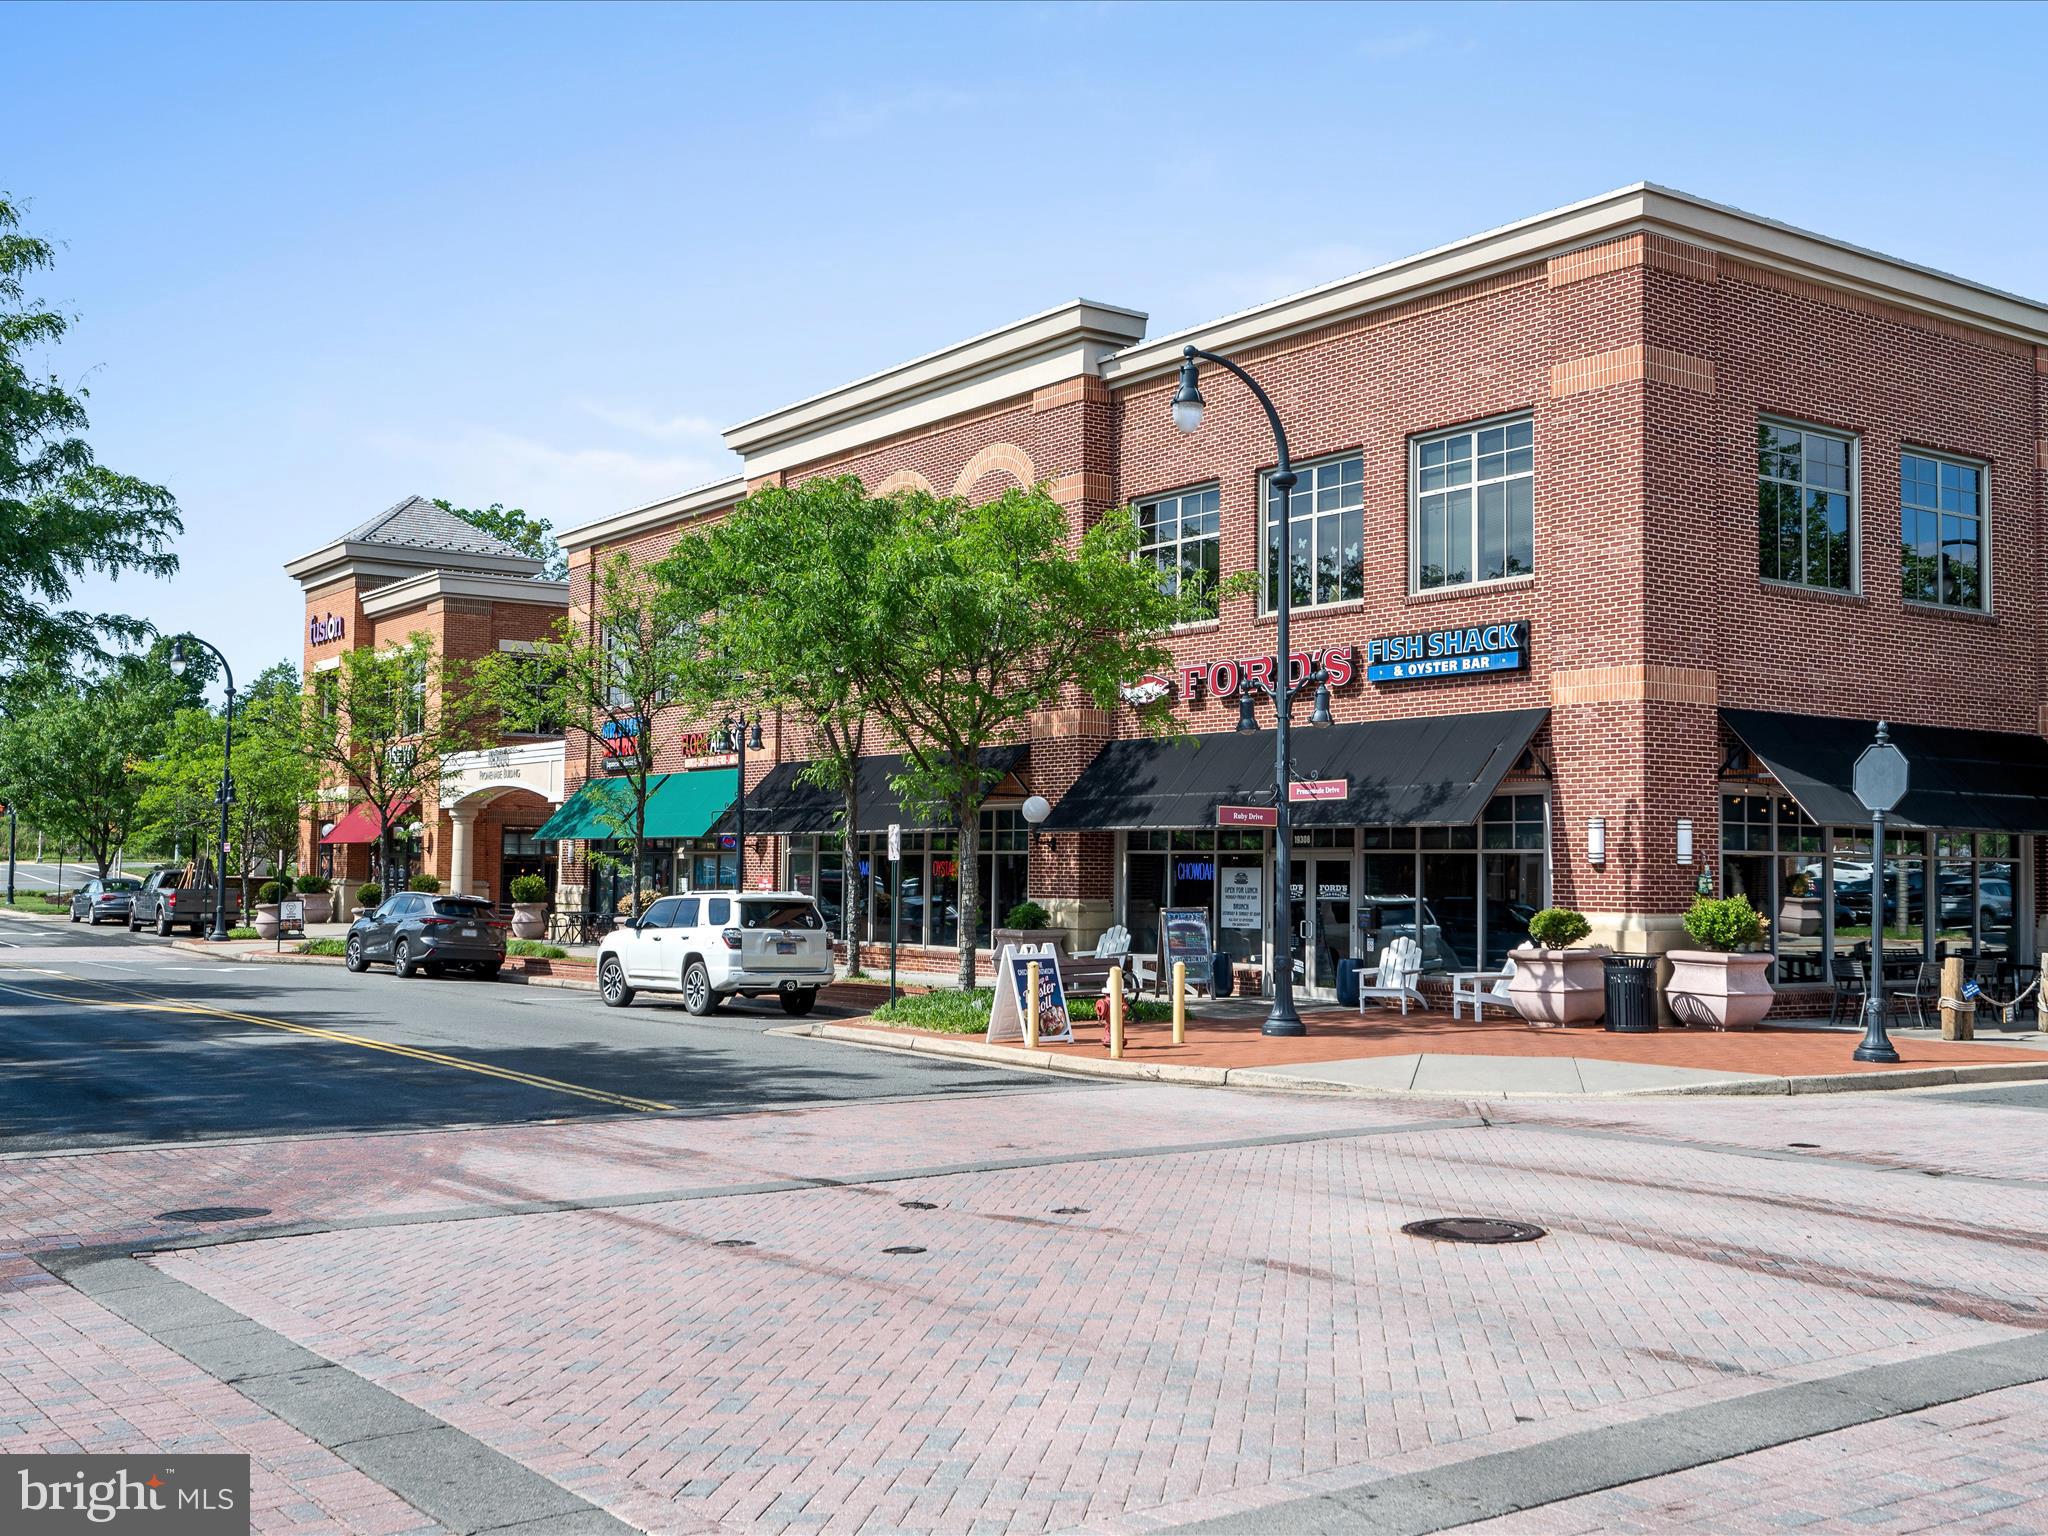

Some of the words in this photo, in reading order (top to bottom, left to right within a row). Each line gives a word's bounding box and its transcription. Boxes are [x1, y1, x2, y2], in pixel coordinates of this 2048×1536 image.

[311, 612, 345, 647] fusion
[1368, 636, 1423, 664] FISH
[1428, 622, 1519, 658] SHACK
[1179, 645, 1352, 701] FORD'S
[1394, 664, 1405, 677] &
[1407, 659, 1458, 676] OYSTER
[1461, 655, 1490, 671] BAR
[1325, 785, 1340, 793] Drive
[1233, 812, 1248, 821] Ruby
[1177, 863, 1215, 880] CHOWDAH
[1224, 886, 1235, 894] OPEN
[1245, 886, 1258, 894] LUNCH
[1319, 884, 1348, 893] FORD'S
